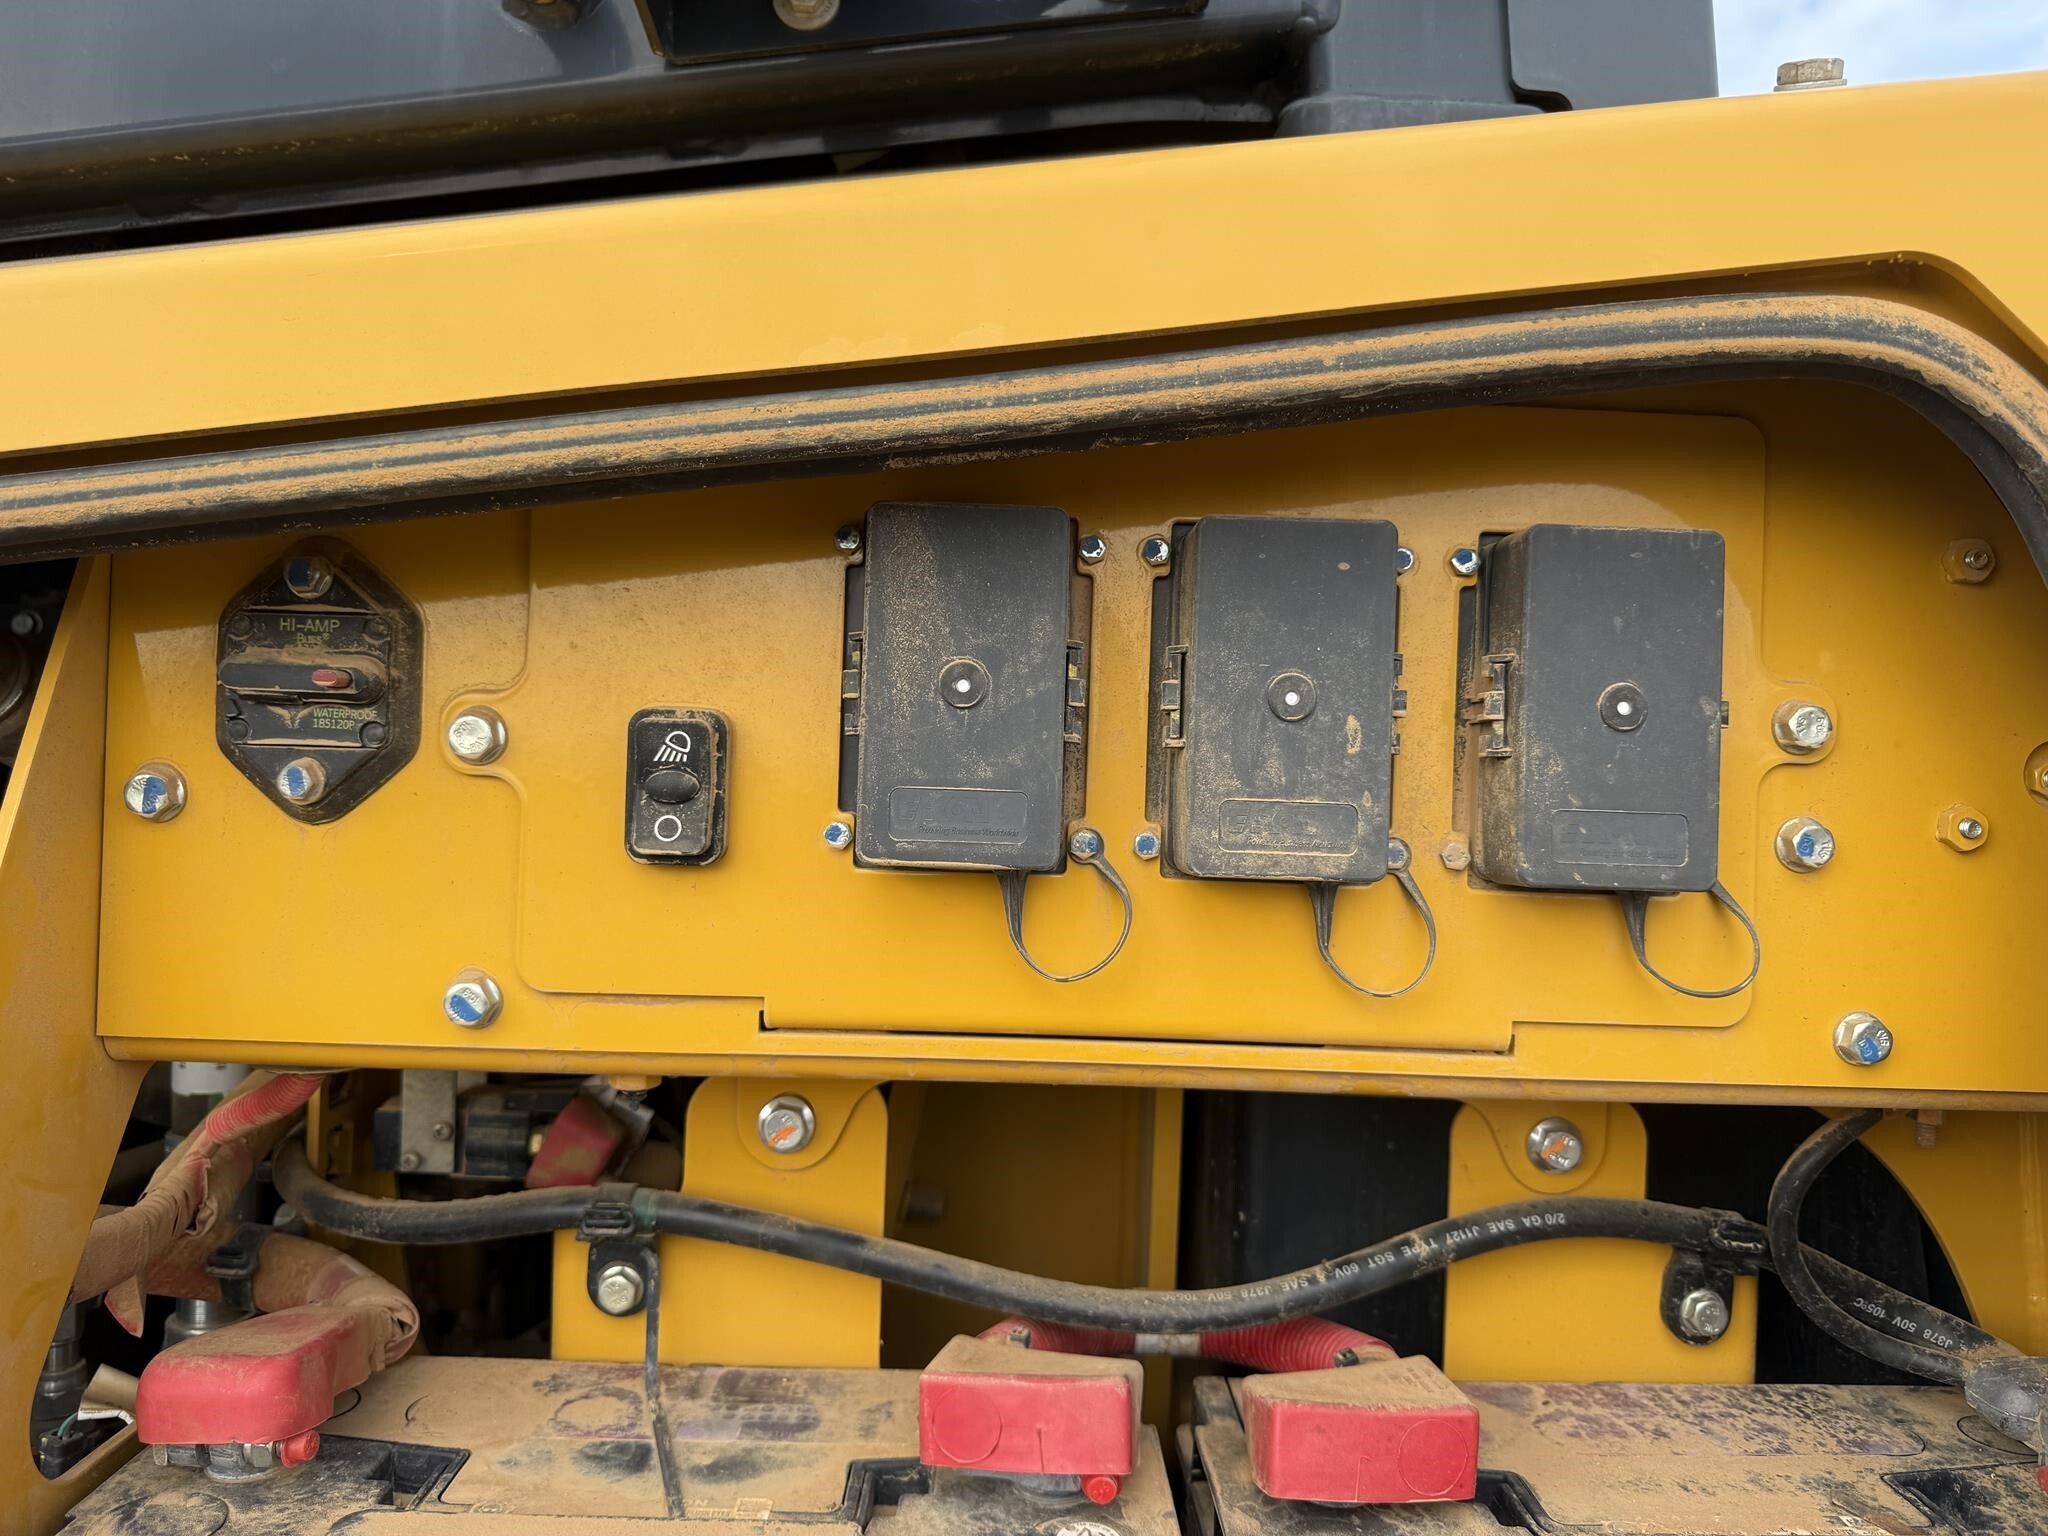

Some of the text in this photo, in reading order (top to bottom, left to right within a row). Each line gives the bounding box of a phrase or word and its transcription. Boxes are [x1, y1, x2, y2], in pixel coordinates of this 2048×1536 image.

[279, 618, 340, 632] HI-AMP
[313, 707, 378, 721] WATERPROOF
[312, 718, 355, 730] 185120P
[1486, 1218, 1514, 1233] SAE
[1520, 1214, 1541, 1228] GA
[1544, 1212, 1565, 1226] 2/0
[1444, 1225, 1480, 1243] J1127
[1400, 1237, 1438, 1256] TYPE
[1366, 1251, 1395, 1268] SGT
[1333, 1261, 1359, 1278] 60V
[1240, 1284, 1272, 1299] J378
[1279, 1276, 1309, 1292] SAE
[1891, 1316, 1917, 1333] 50V
[1922, 1328, 1953, 1349] J378
